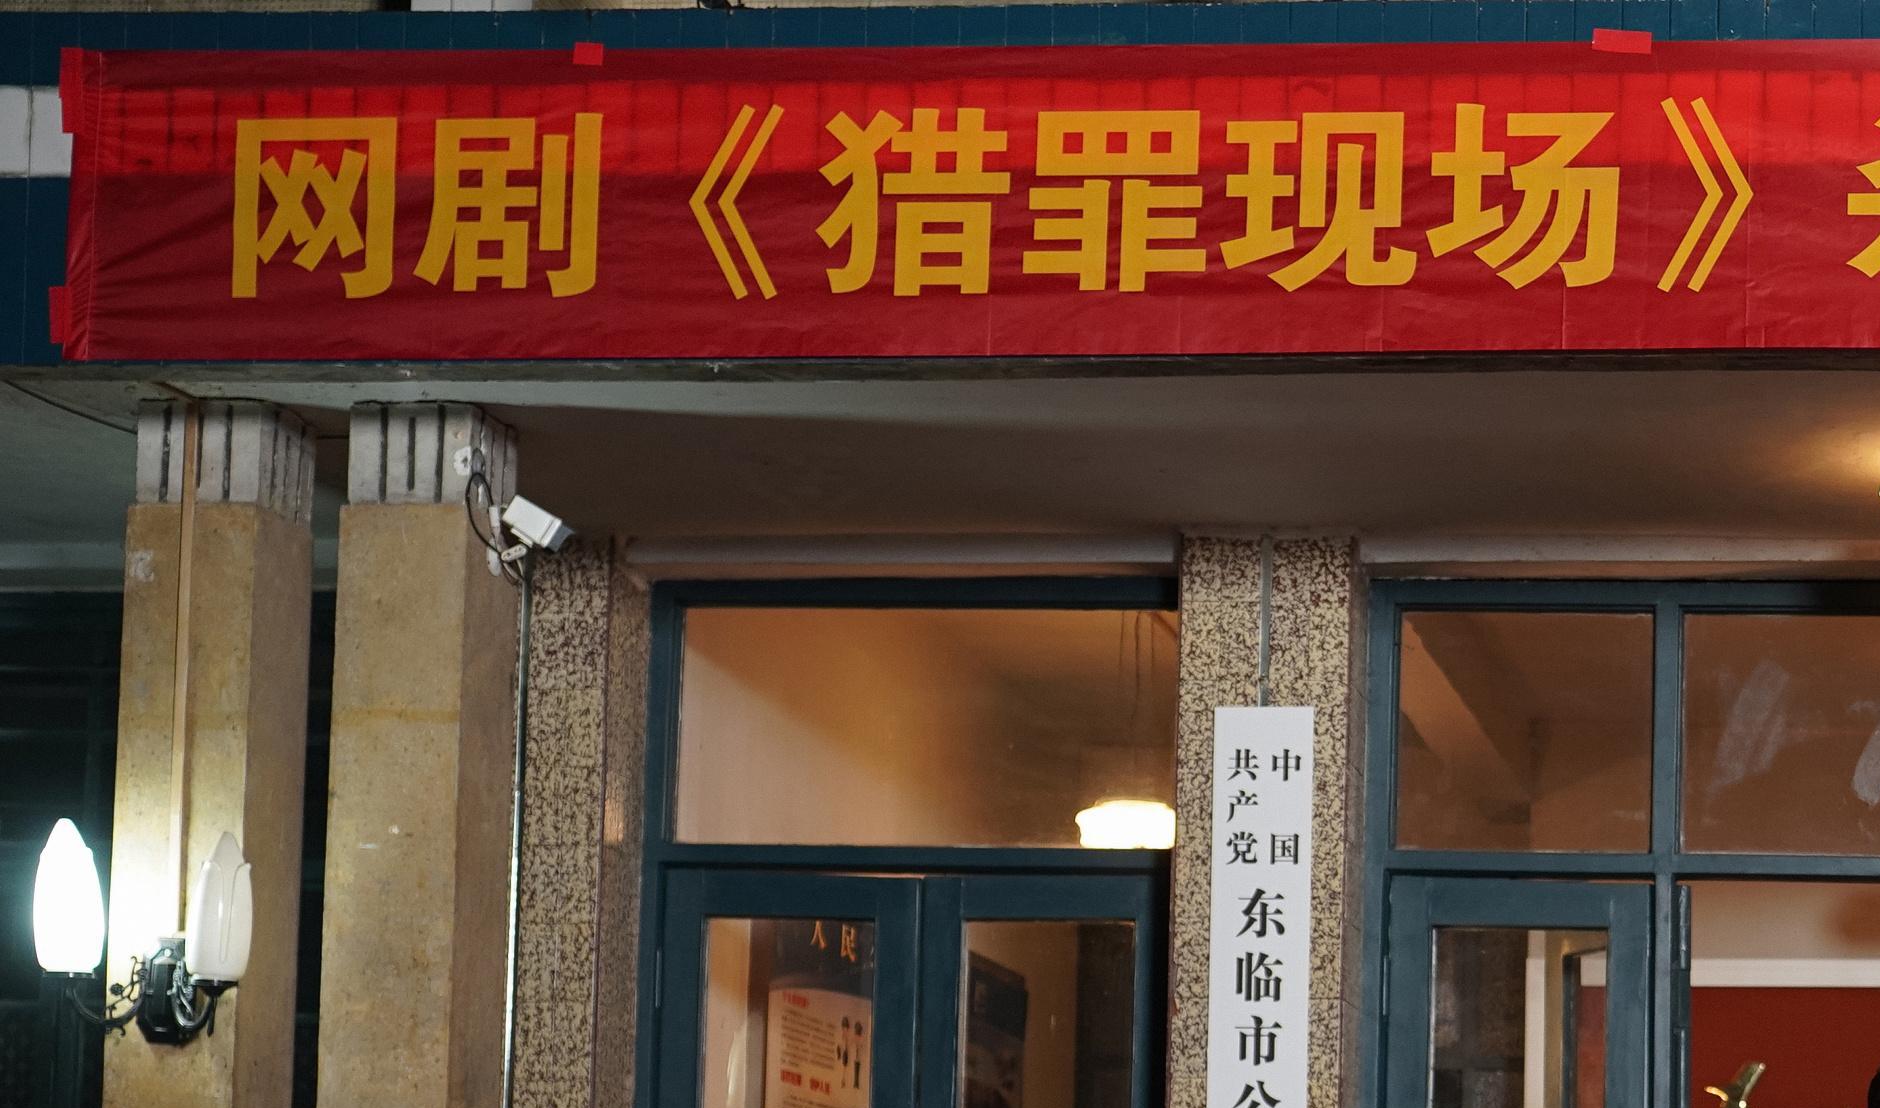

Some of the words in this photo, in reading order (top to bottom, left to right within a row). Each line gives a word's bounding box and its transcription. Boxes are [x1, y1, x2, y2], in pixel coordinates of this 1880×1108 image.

[1225, 748, 1261, 866] 共产党
[1269, 748, 1302, 866] 中国
